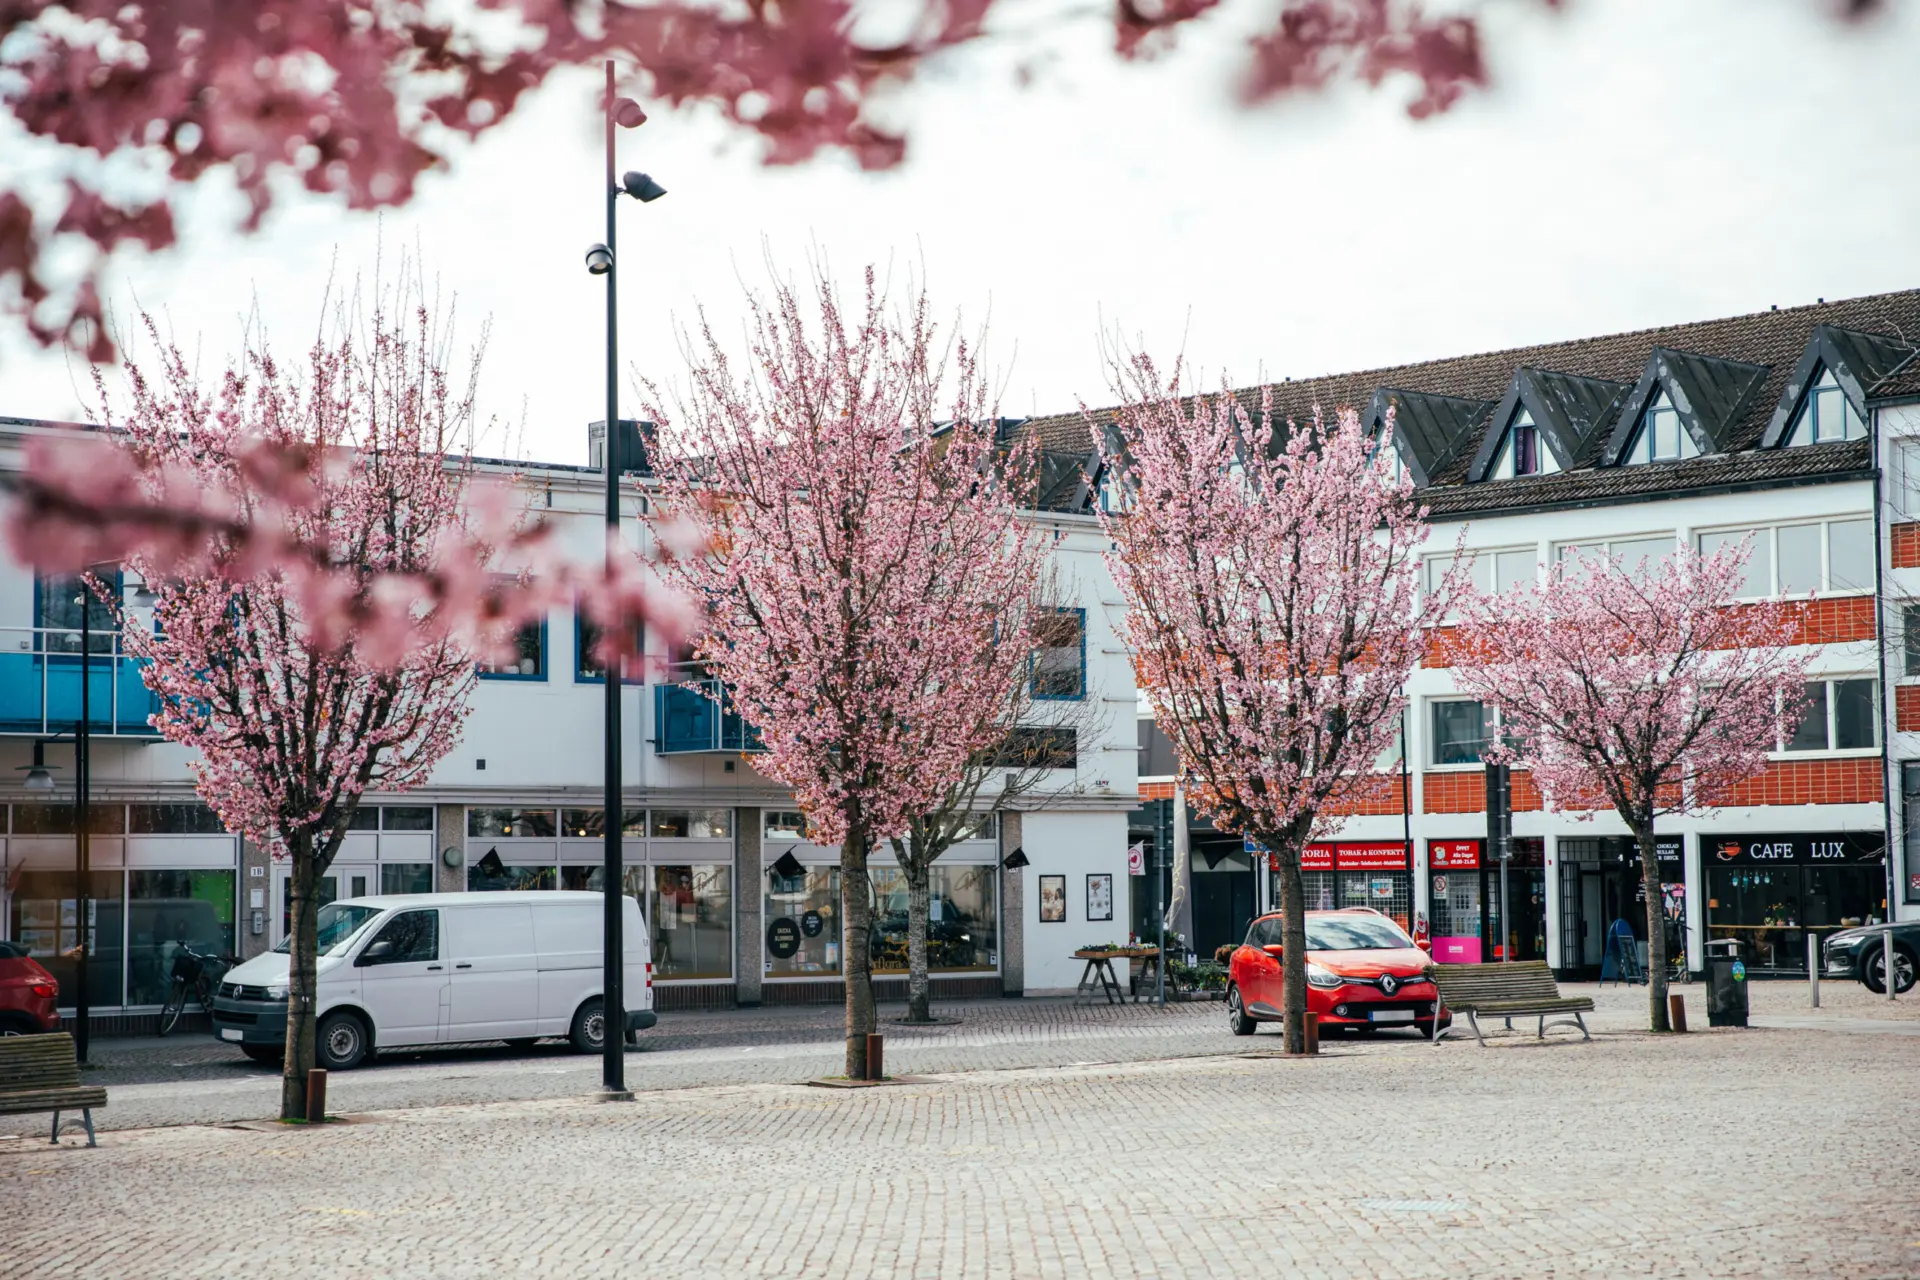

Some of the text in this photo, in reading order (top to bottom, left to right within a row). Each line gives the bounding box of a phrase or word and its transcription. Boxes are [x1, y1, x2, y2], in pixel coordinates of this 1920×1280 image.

[1301, 849, 1331, 858] TORIA
[1368, 848, 1406, 856] KONFEKTY
[1750, 842, 1845, 859] CAFE LUX
[252, 868, 262, 876] 1B
